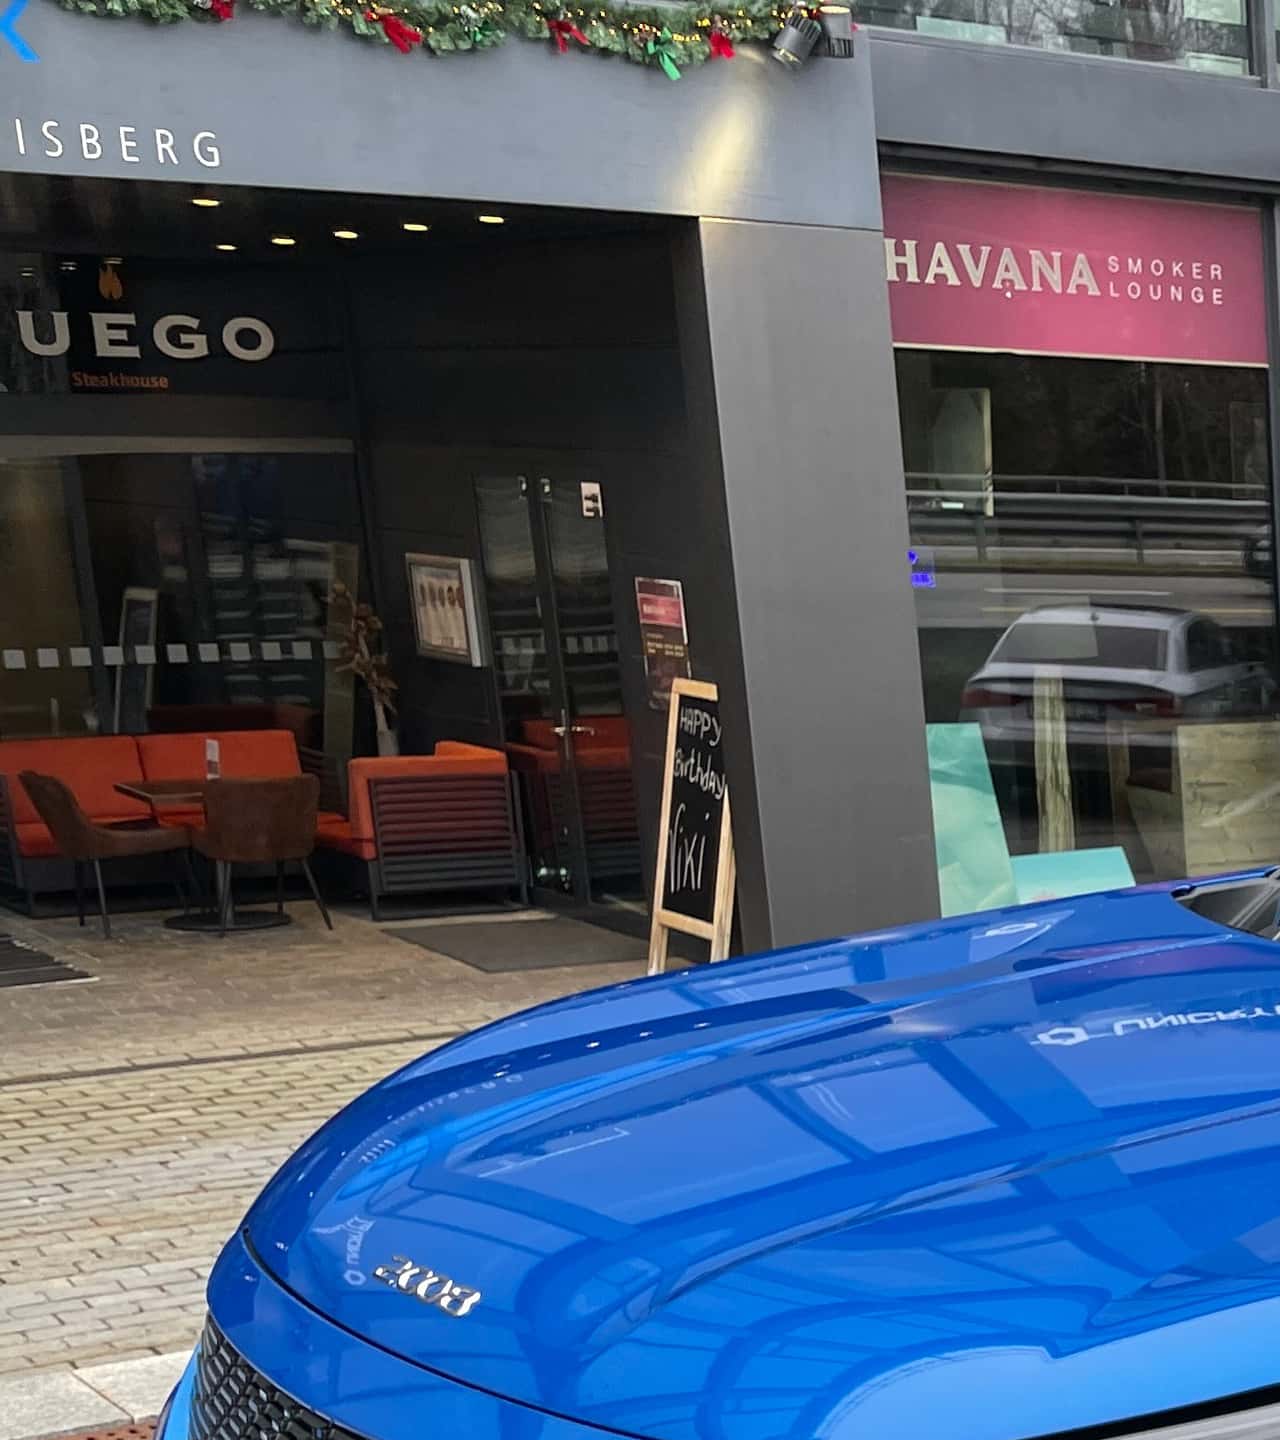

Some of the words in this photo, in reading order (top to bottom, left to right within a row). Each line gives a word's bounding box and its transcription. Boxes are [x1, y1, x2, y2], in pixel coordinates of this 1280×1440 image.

[15, 118, 220, 167] ISBERG
[884, 238, 1101, 296] HAVANA
[1107, 255, 1223, 280] SMOKER
[1109, 282, 1223, 305] LOUNGE
[16, 310, 275, 361] UEGO
[72, 371, 169, 389] Steakhouse
[371, 1254, 482, 1317] 2008
